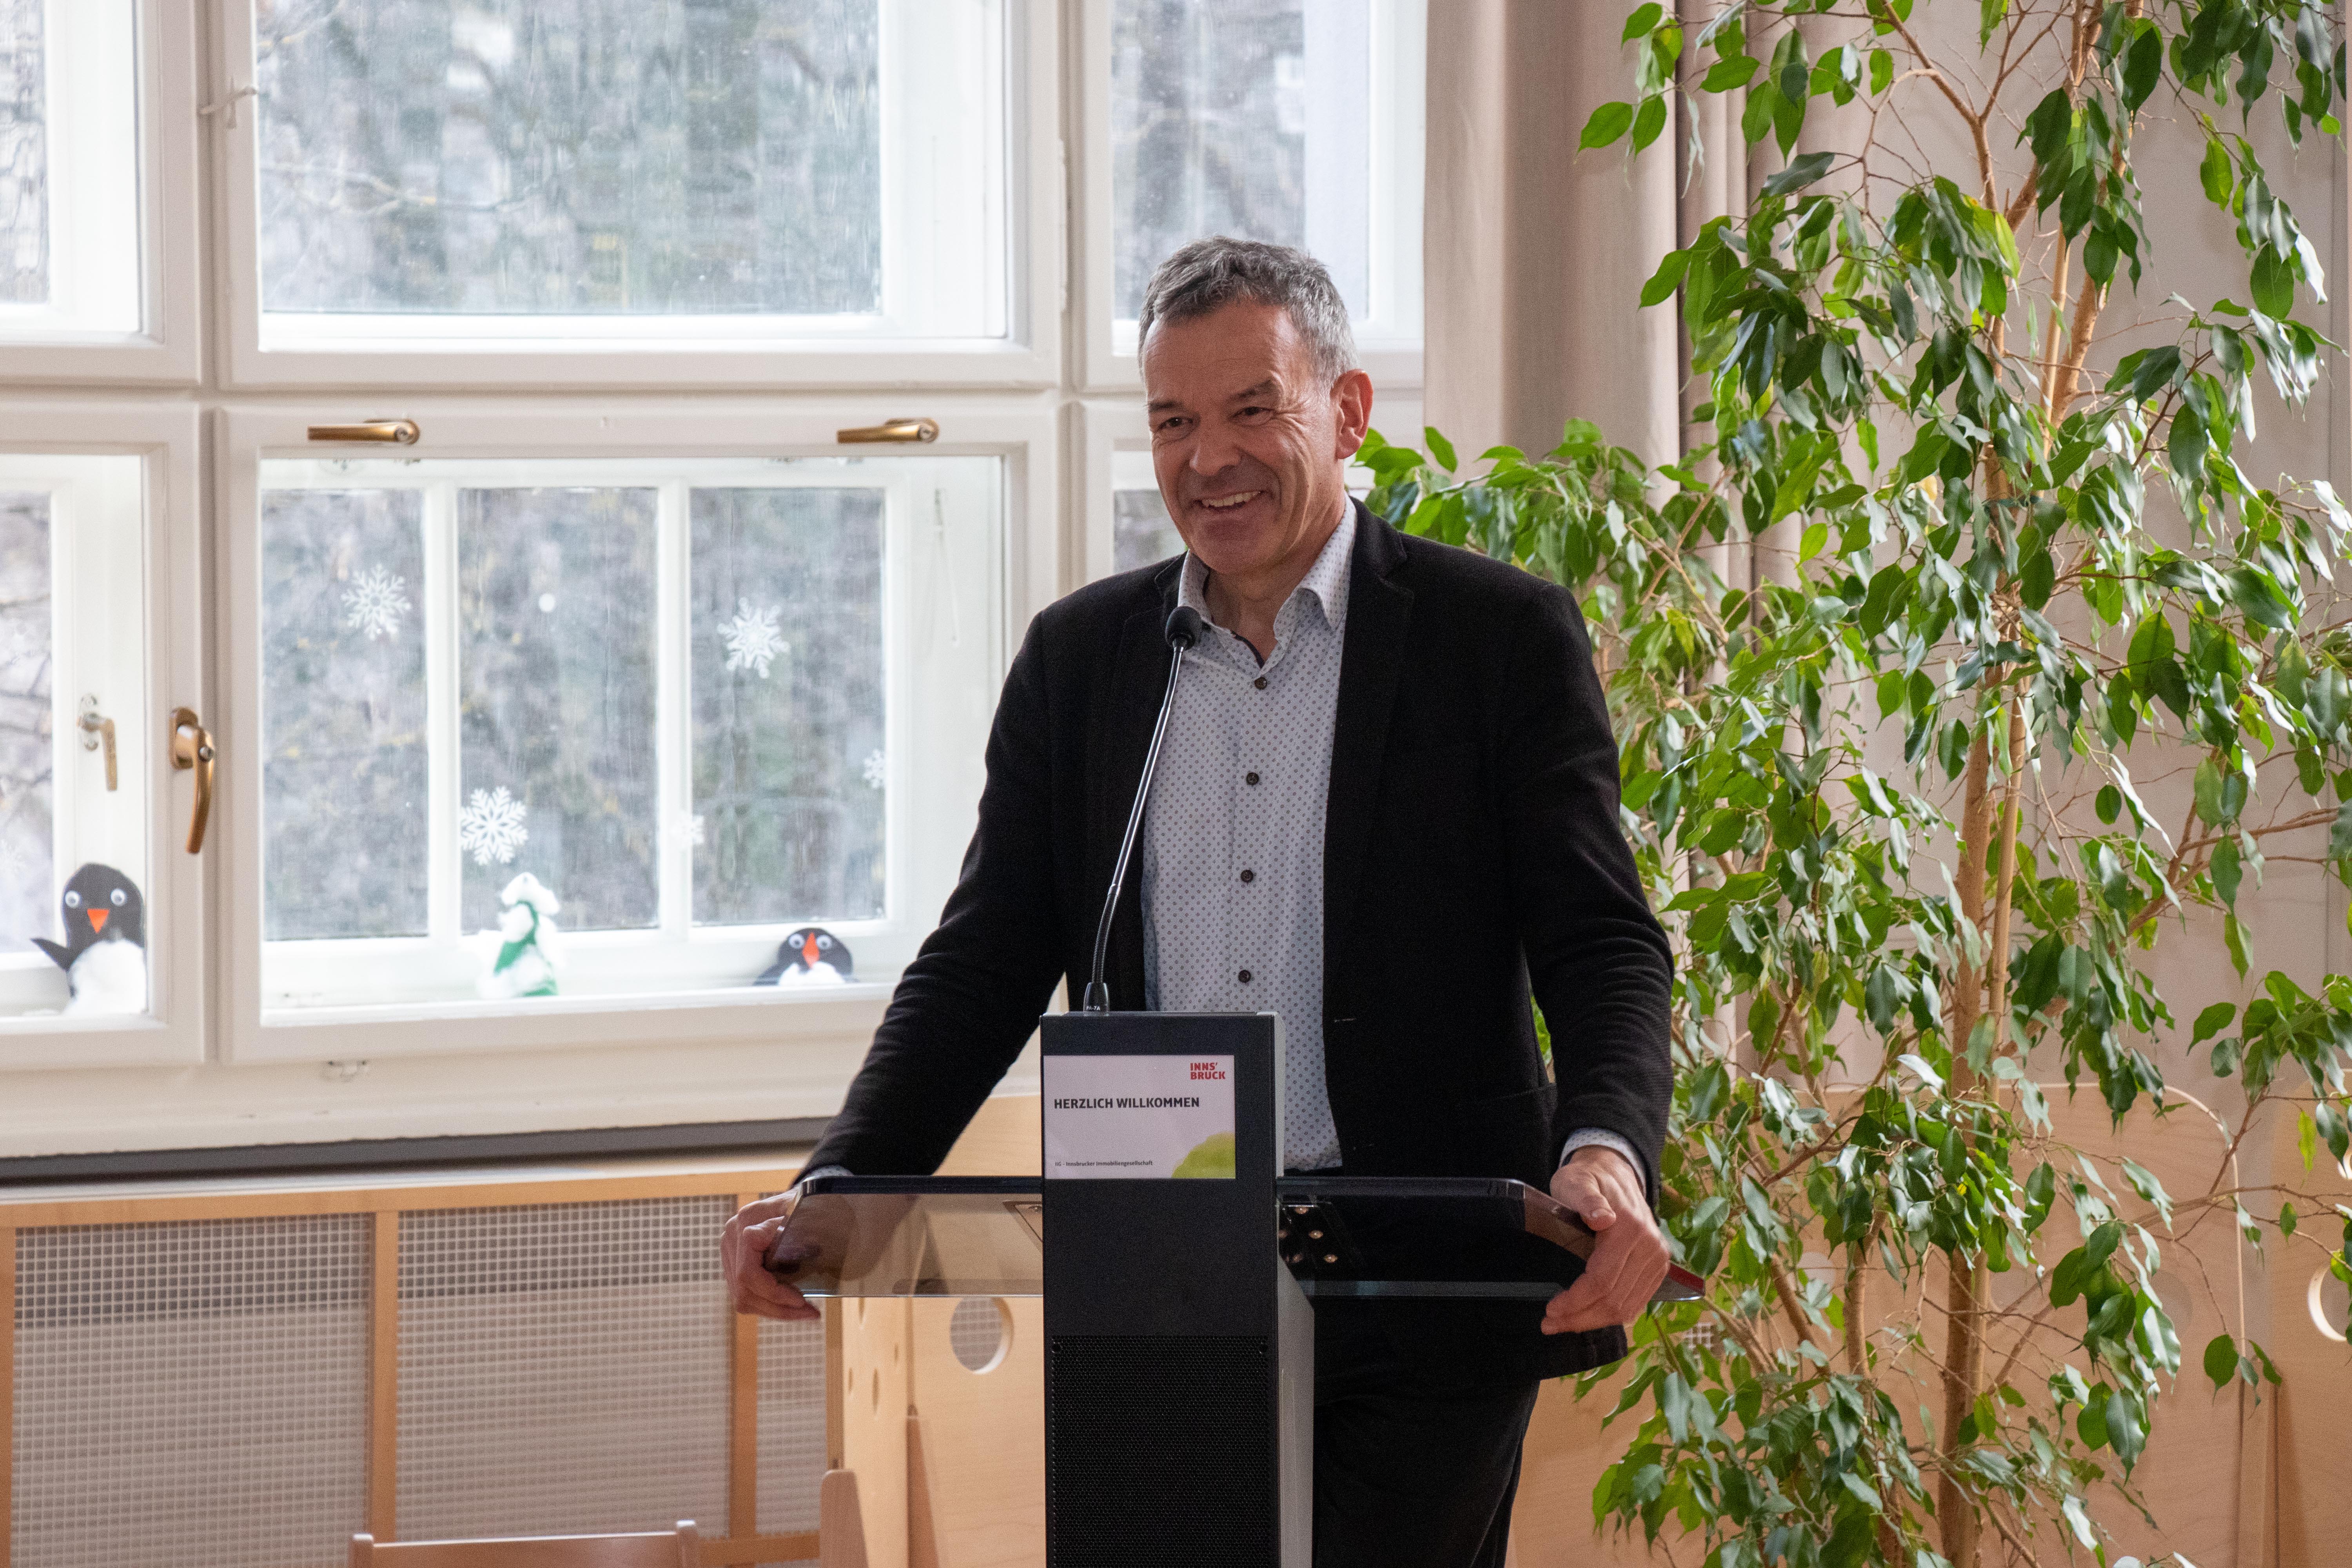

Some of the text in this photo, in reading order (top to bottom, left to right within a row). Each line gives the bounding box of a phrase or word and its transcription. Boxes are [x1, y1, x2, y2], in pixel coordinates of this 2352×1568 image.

[1190, 1071, 1225, 1080] BRUCK
[1054, 1097, 1200, 1109] HERZLICH WILLKOMMEN
